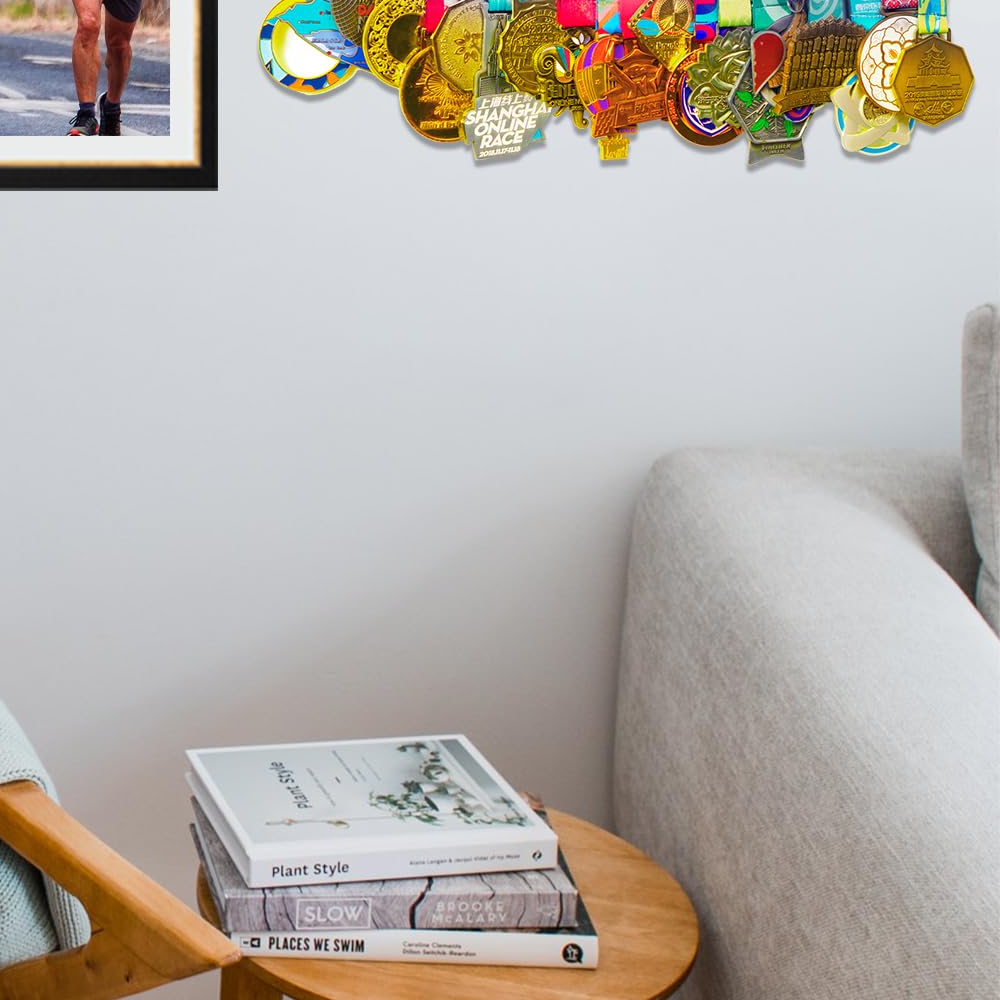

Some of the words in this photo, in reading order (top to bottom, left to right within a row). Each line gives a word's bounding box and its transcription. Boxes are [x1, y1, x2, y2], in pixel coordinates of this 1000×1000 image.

[474, 114, 538, 137] ONLINE
[480, 129, 524, 149] RACE
[272, 864, 308, 878] Plant
[313, 861, 350, 877] Style
[304, 905, 364, 922] SLOW
[435, 900, 505, 913] BROOKE
[432, 912, 508, 924] McALARY
[268, 936, 310, 951] PLACES
[313, 938, 330, 952] WE
[333, 939, 365, 953] SWIM
